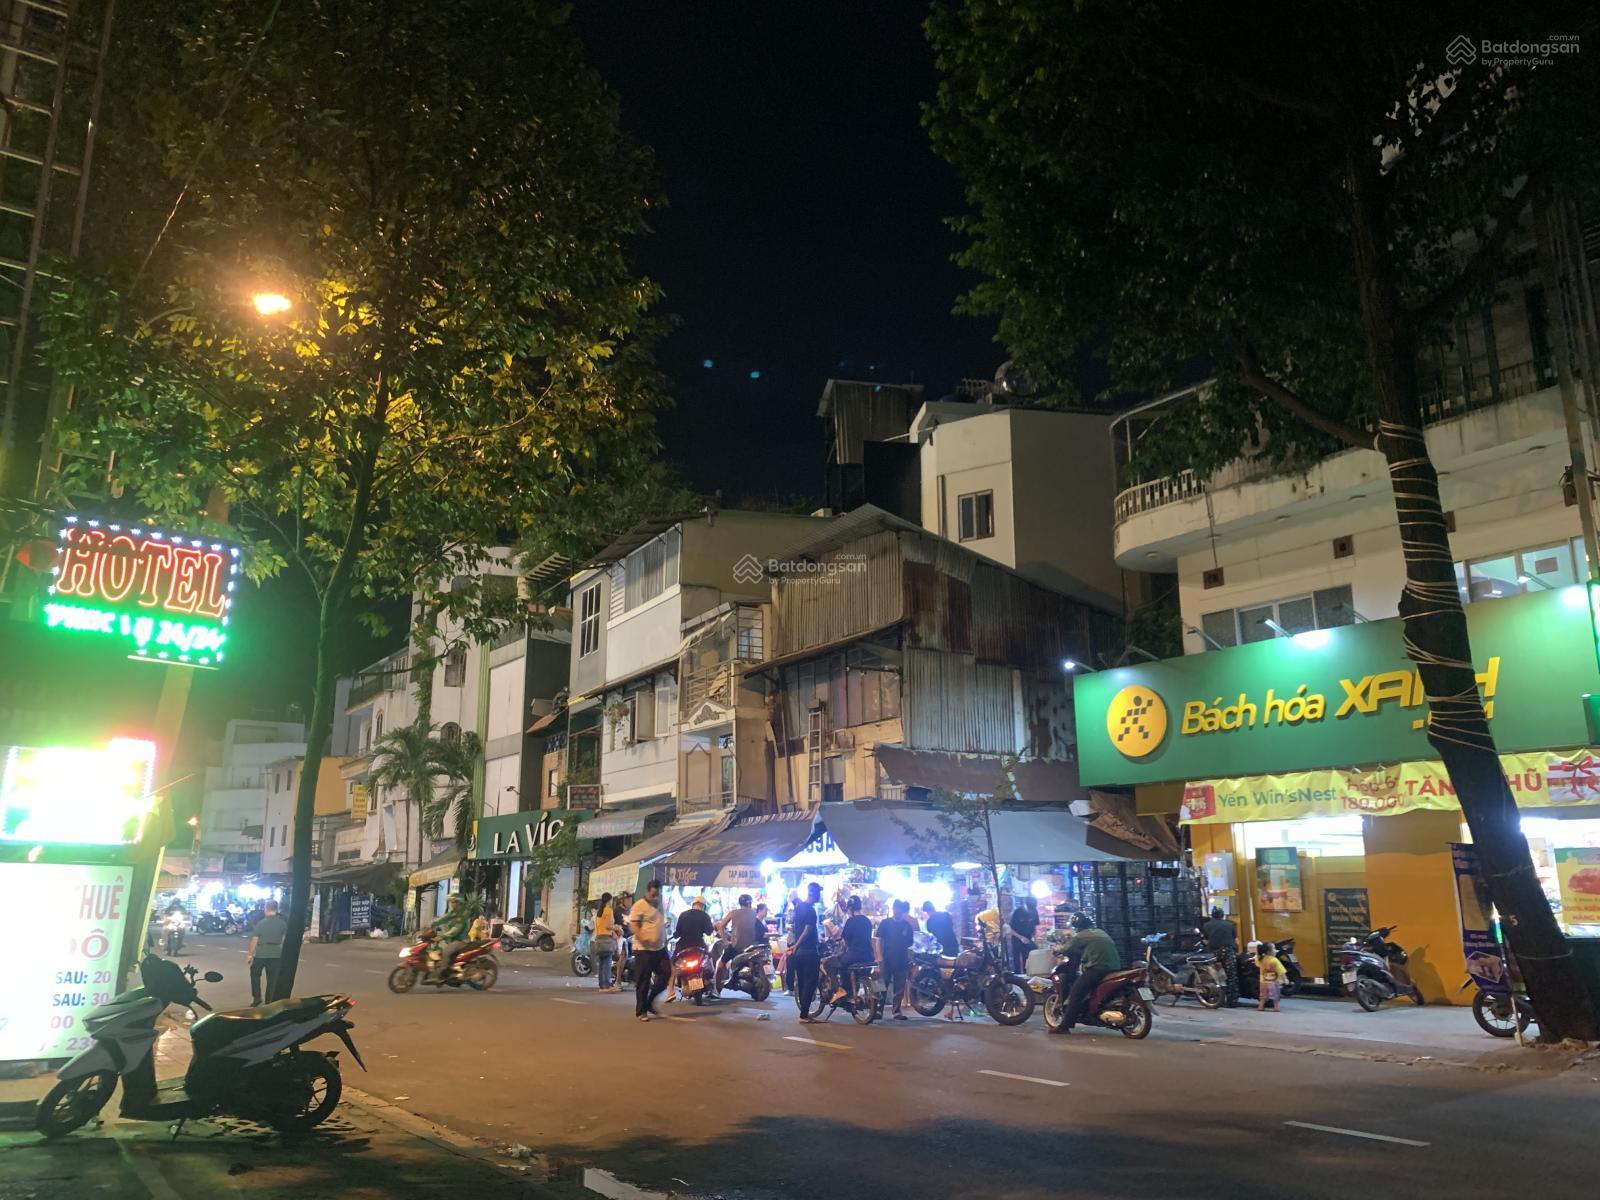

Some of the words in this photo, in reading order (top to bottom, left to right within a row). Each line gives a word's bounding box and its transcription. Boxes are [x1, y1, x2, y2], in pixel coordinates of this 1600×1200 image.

[56, 528, 226, 618] HOTEL
[1181, 692, 1257, 735] Bách
[1263, 683, 1326, 725] hóa
[493, 830, 521, 856] LA
[74, 874, 125, 921] HUÊ
[55, 970, 89, 985] SAU:
[92, 970, 112, 985] 20
[52, 992, 86, 1007] SAU:
